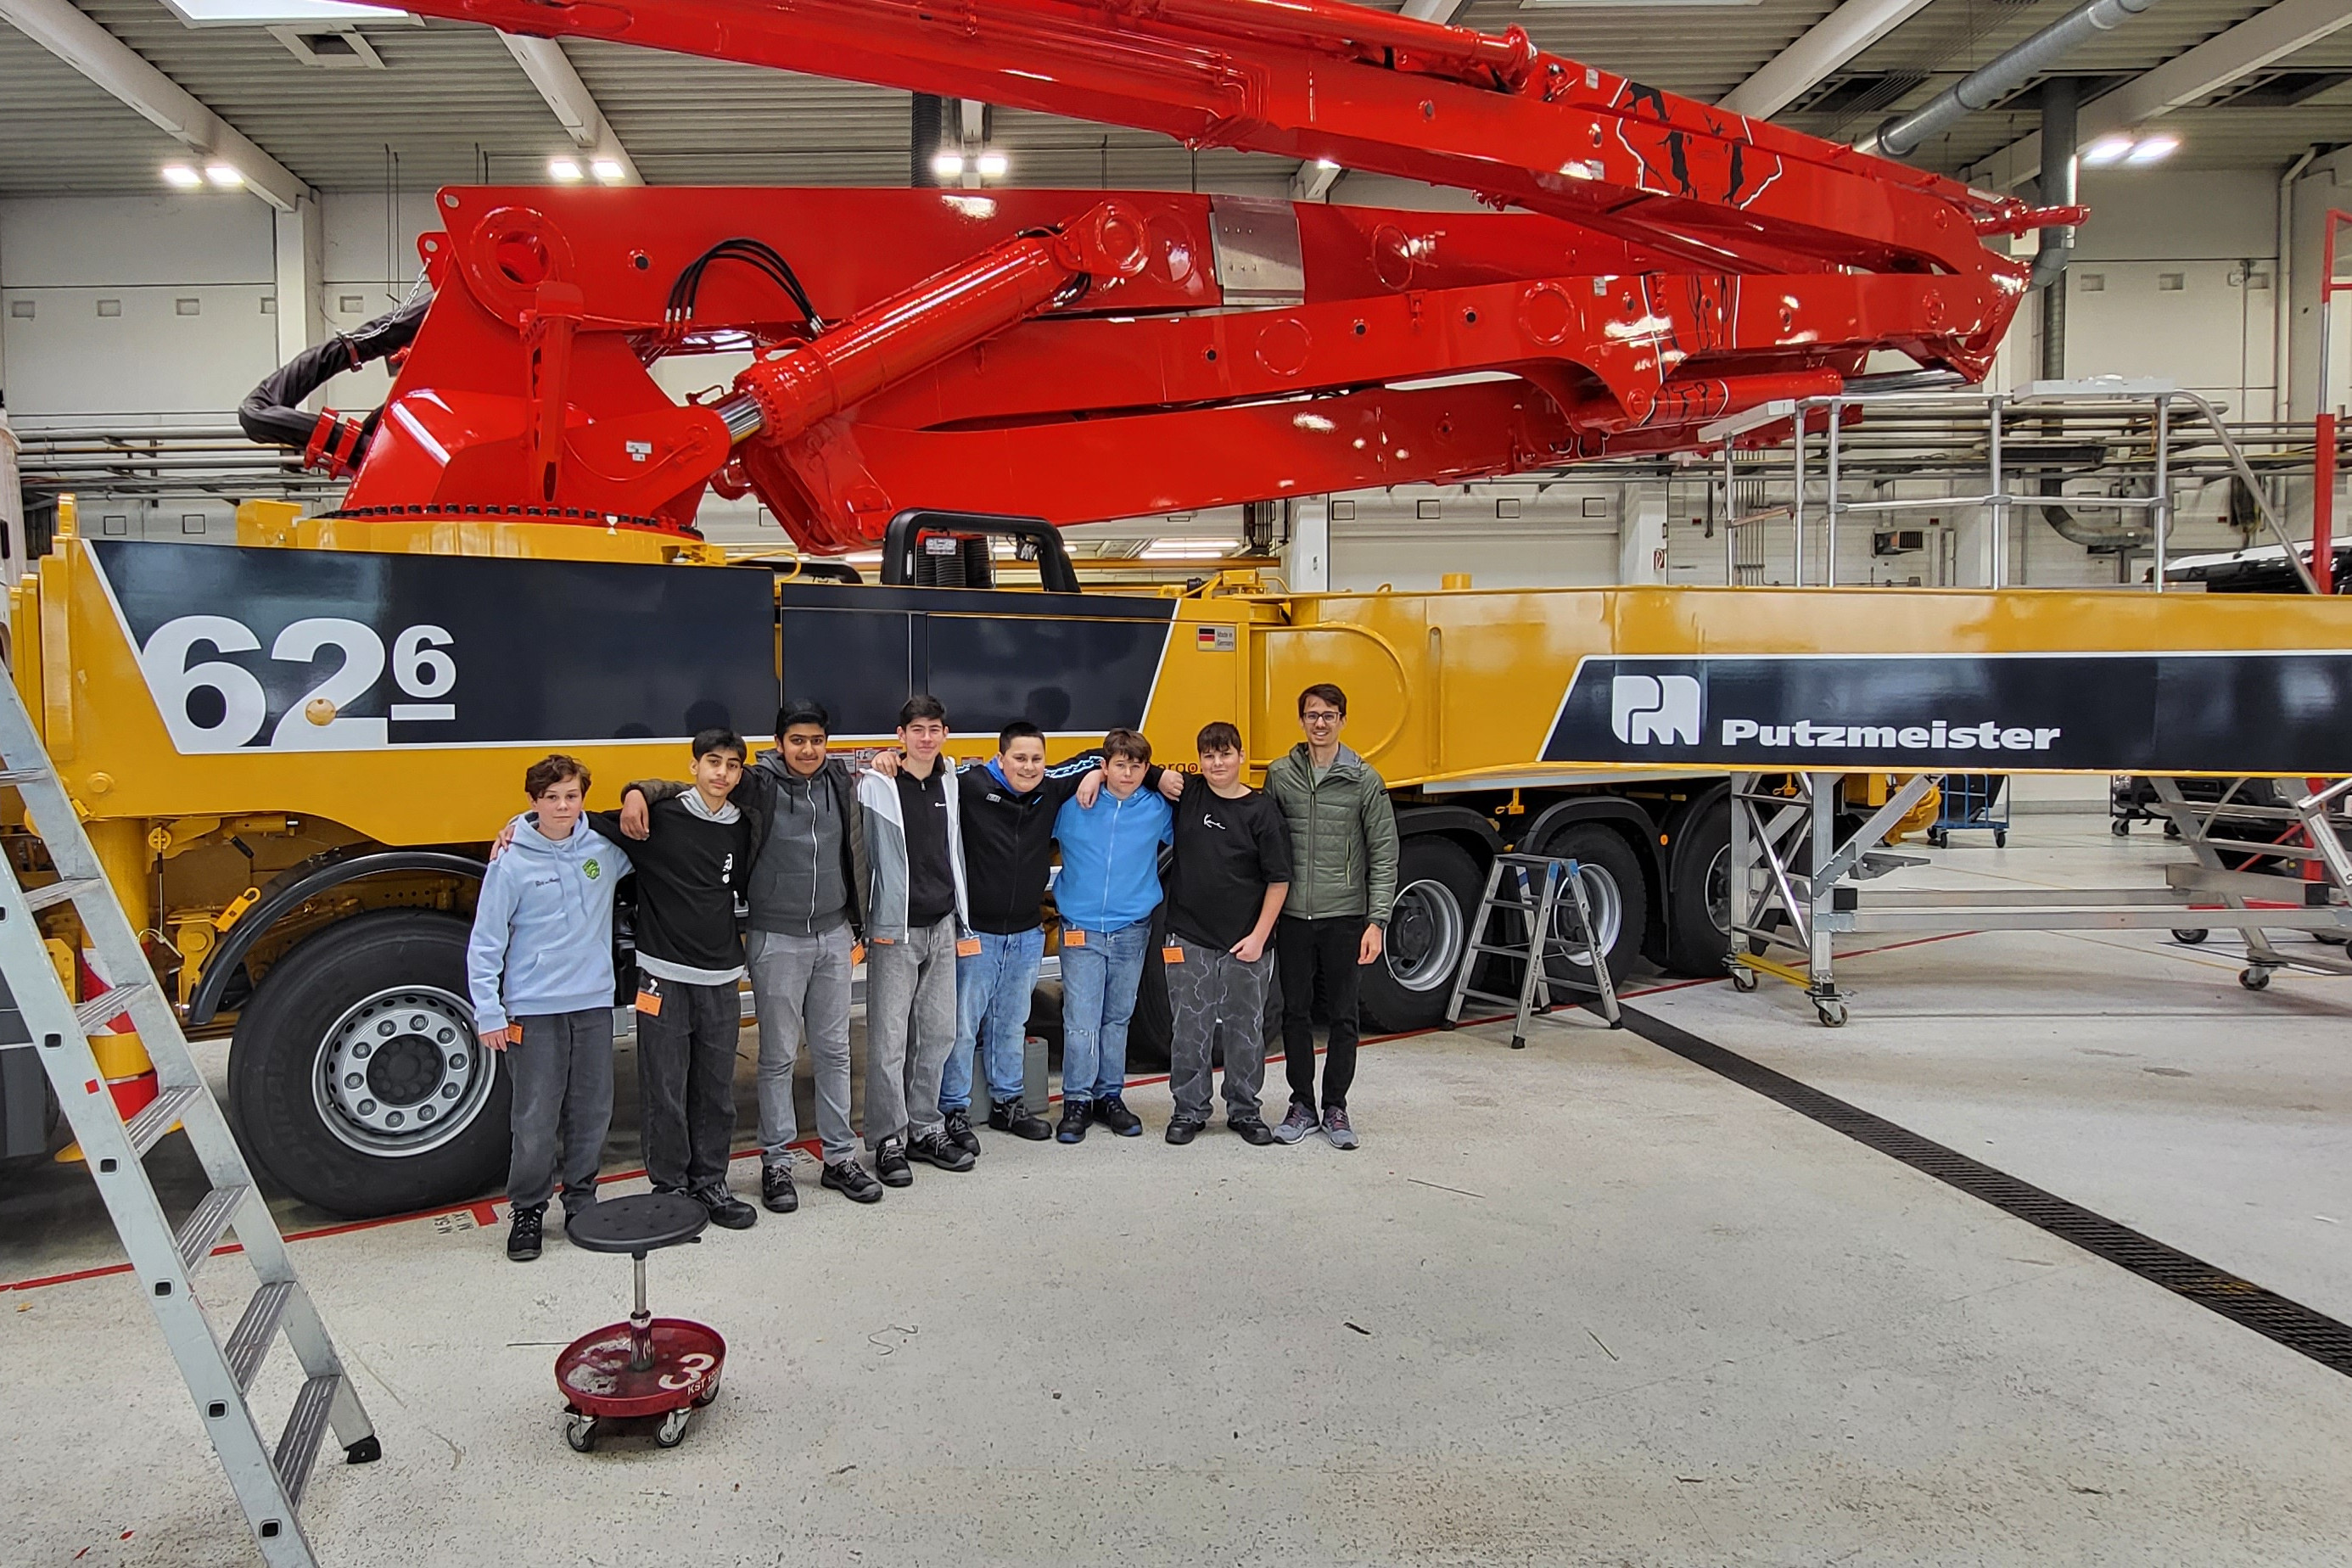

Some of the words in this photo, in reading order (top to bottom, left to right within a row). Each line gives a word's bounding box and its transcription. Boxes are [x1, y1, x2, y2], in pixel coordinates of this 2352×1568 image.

[1722, 720, 2061, 750] Putzmeister
[1596, 951, 1607, 982] Station
[658, 1352, 715, 1390] 3
